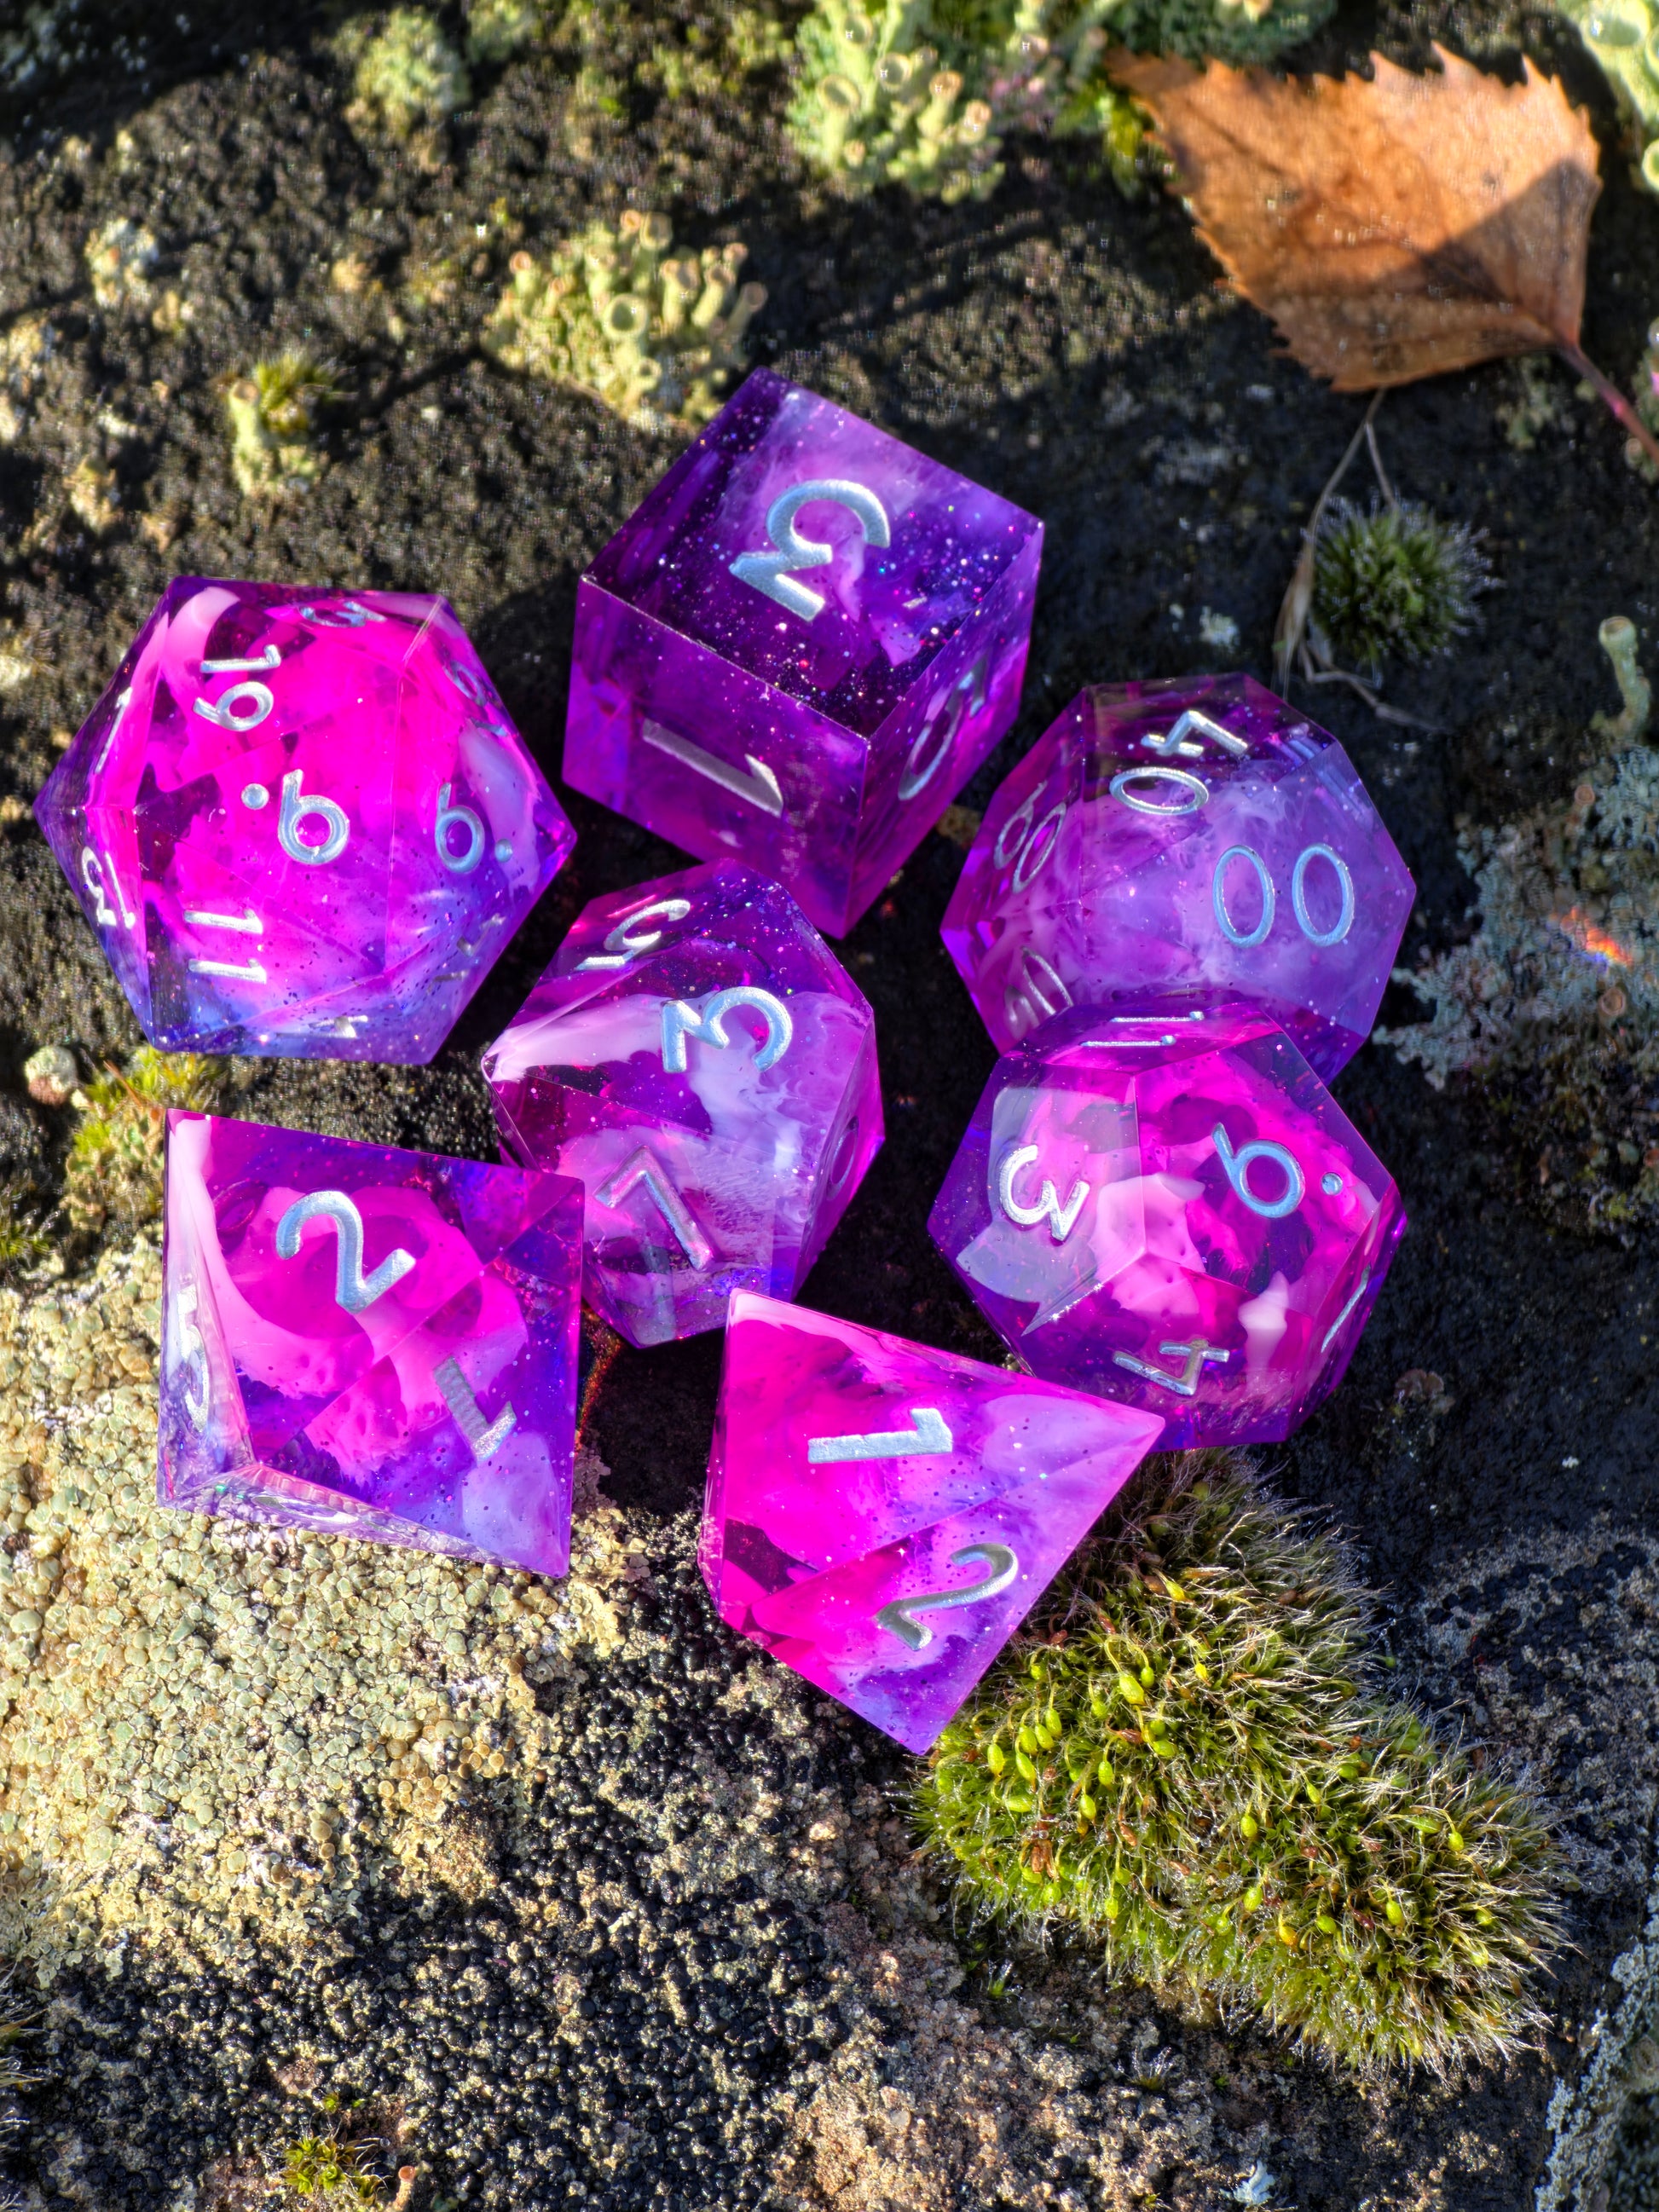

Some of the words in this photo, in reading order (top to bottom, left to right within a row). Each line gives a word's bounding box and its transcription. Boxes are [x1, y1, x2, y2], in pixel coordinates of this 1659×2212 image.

[729, 479, 891, 621] 3
[641, 718, 784, 817] 1
[574, 898, 691, 971] 5
[1212, 842, 1355, 948] 00
[183, 909, 267, 984] 11
[661, 985, 793, 1073] 3
[596, 1147, 715, 1271] 7
[998, 1144, 1090, 1242] 3
[275, 1190, 417, 1314] 2
[807, 1407, 953, 1464] 1
[876, 1542, 1020, 1651] 2
